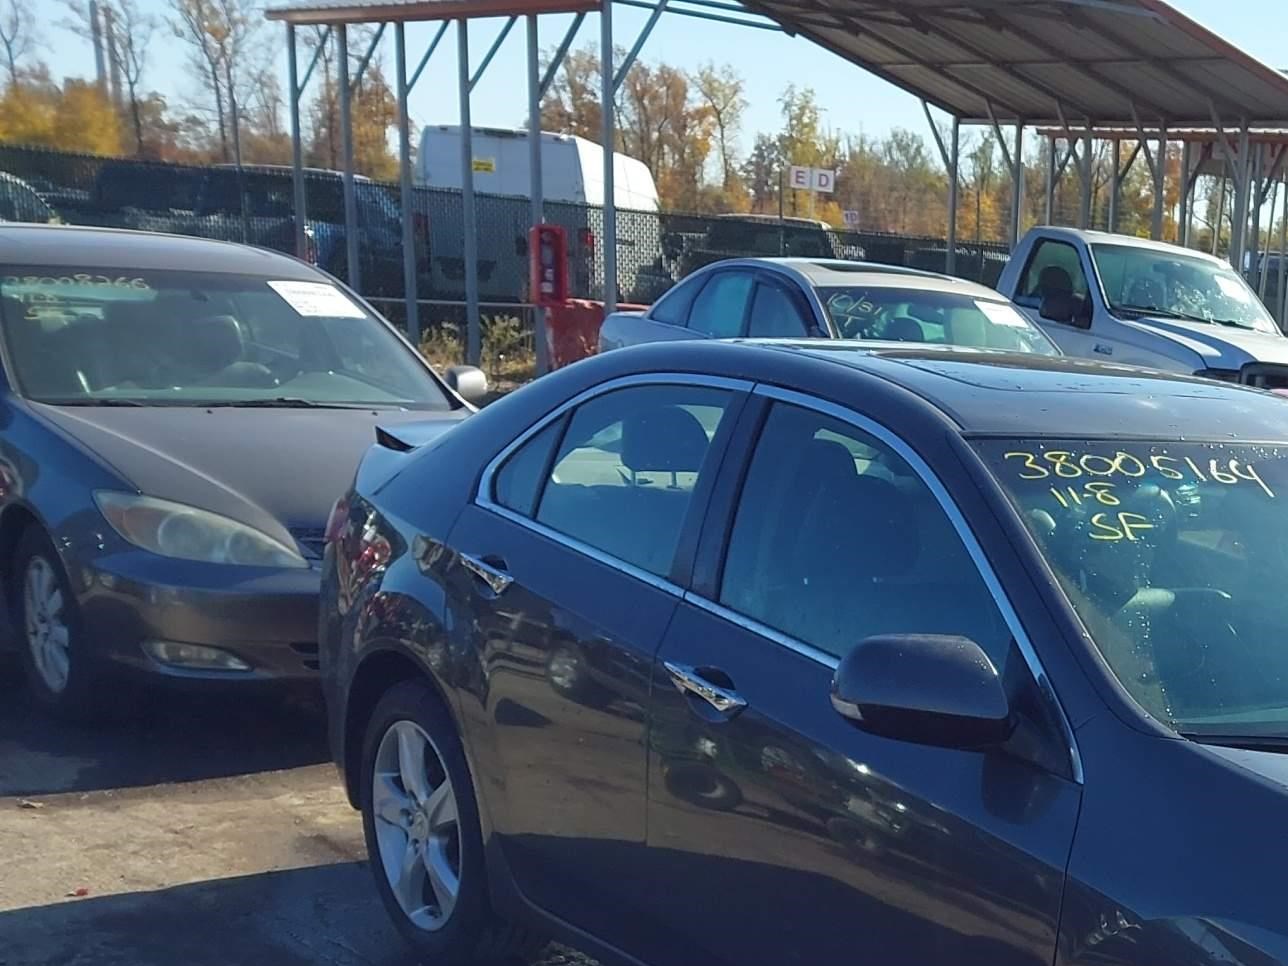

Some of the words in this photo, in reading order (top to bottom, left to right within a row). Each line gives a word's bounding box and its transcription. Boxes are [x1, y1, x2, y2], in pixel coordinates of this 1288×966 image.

[795, 170, 806, 185] E
[818, 174, 829, 188] D
[1004, 451, 1275, 498] 38005164
[1088, 512, 1153, 540] SF
